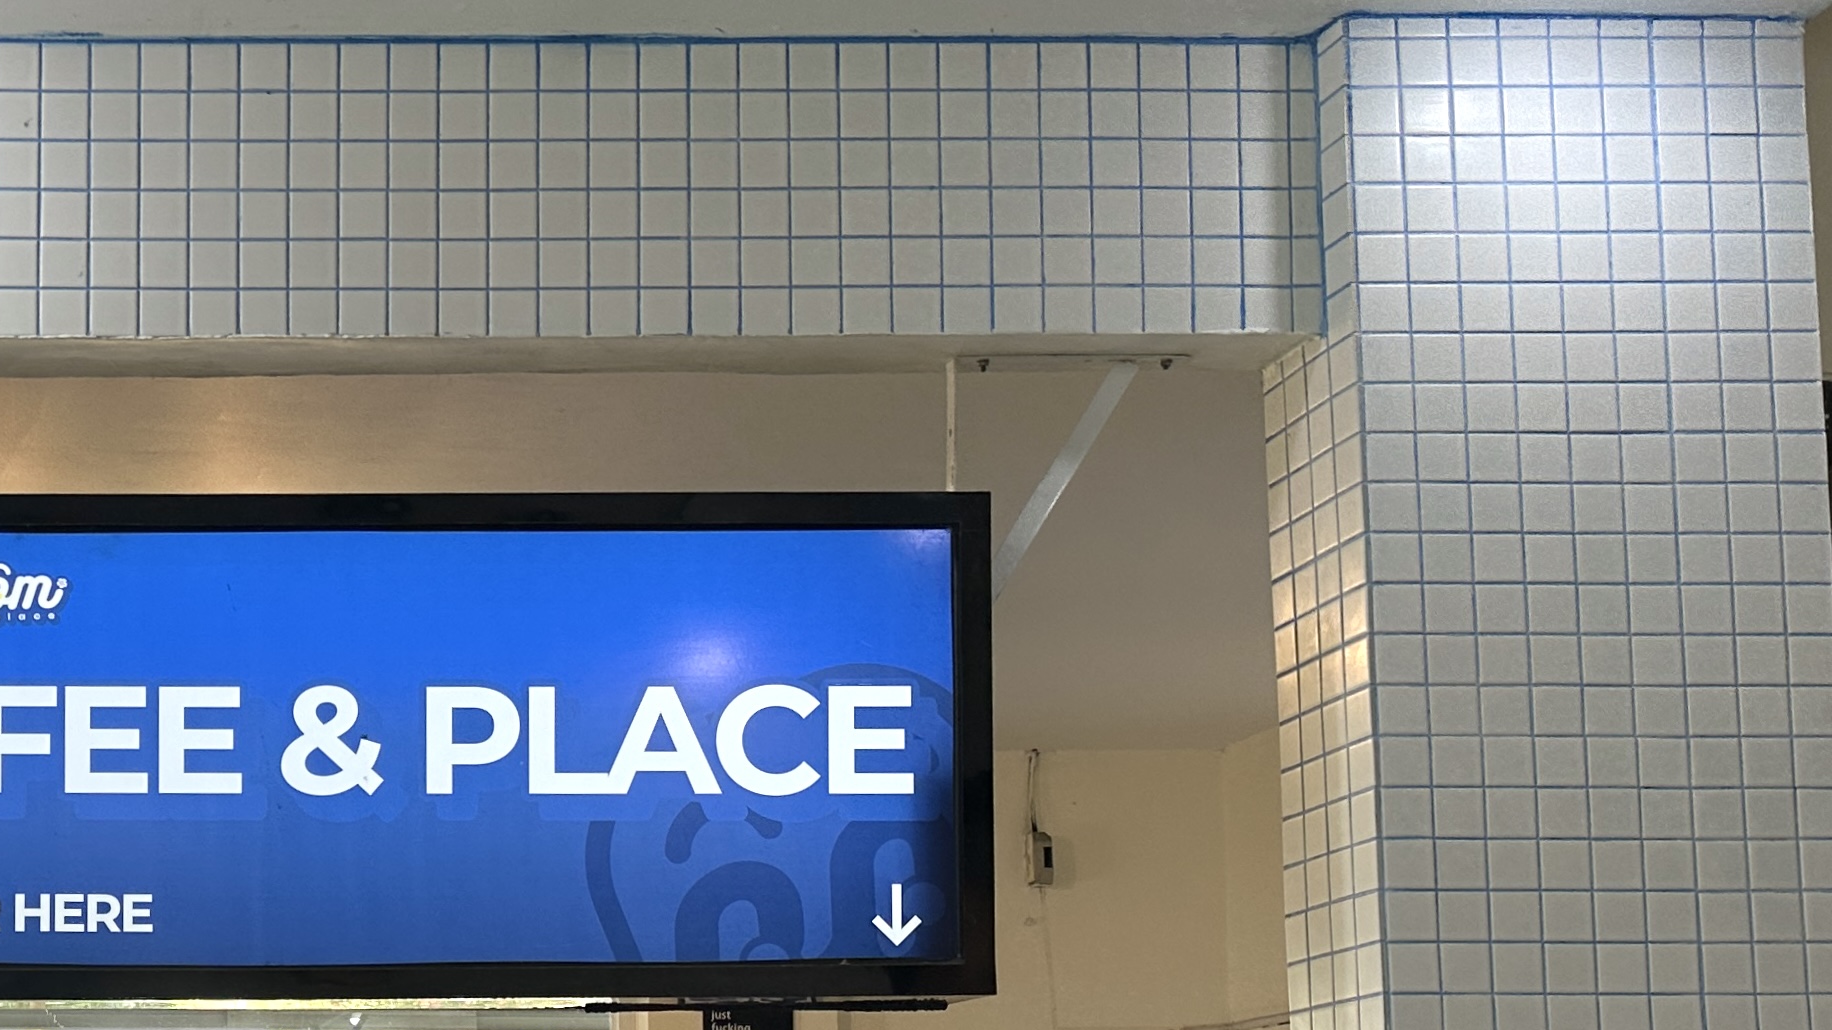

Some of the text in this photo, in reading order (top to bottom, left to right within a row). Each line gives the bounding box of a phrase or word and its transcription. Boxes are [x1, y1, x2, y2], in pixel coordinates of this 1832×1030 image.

[281, 685, 384, 796] &
[426, 684, 914, 796] PLACE
[15, 893, 153, 932] HERE
[710, 1010, 731, 1022] just
